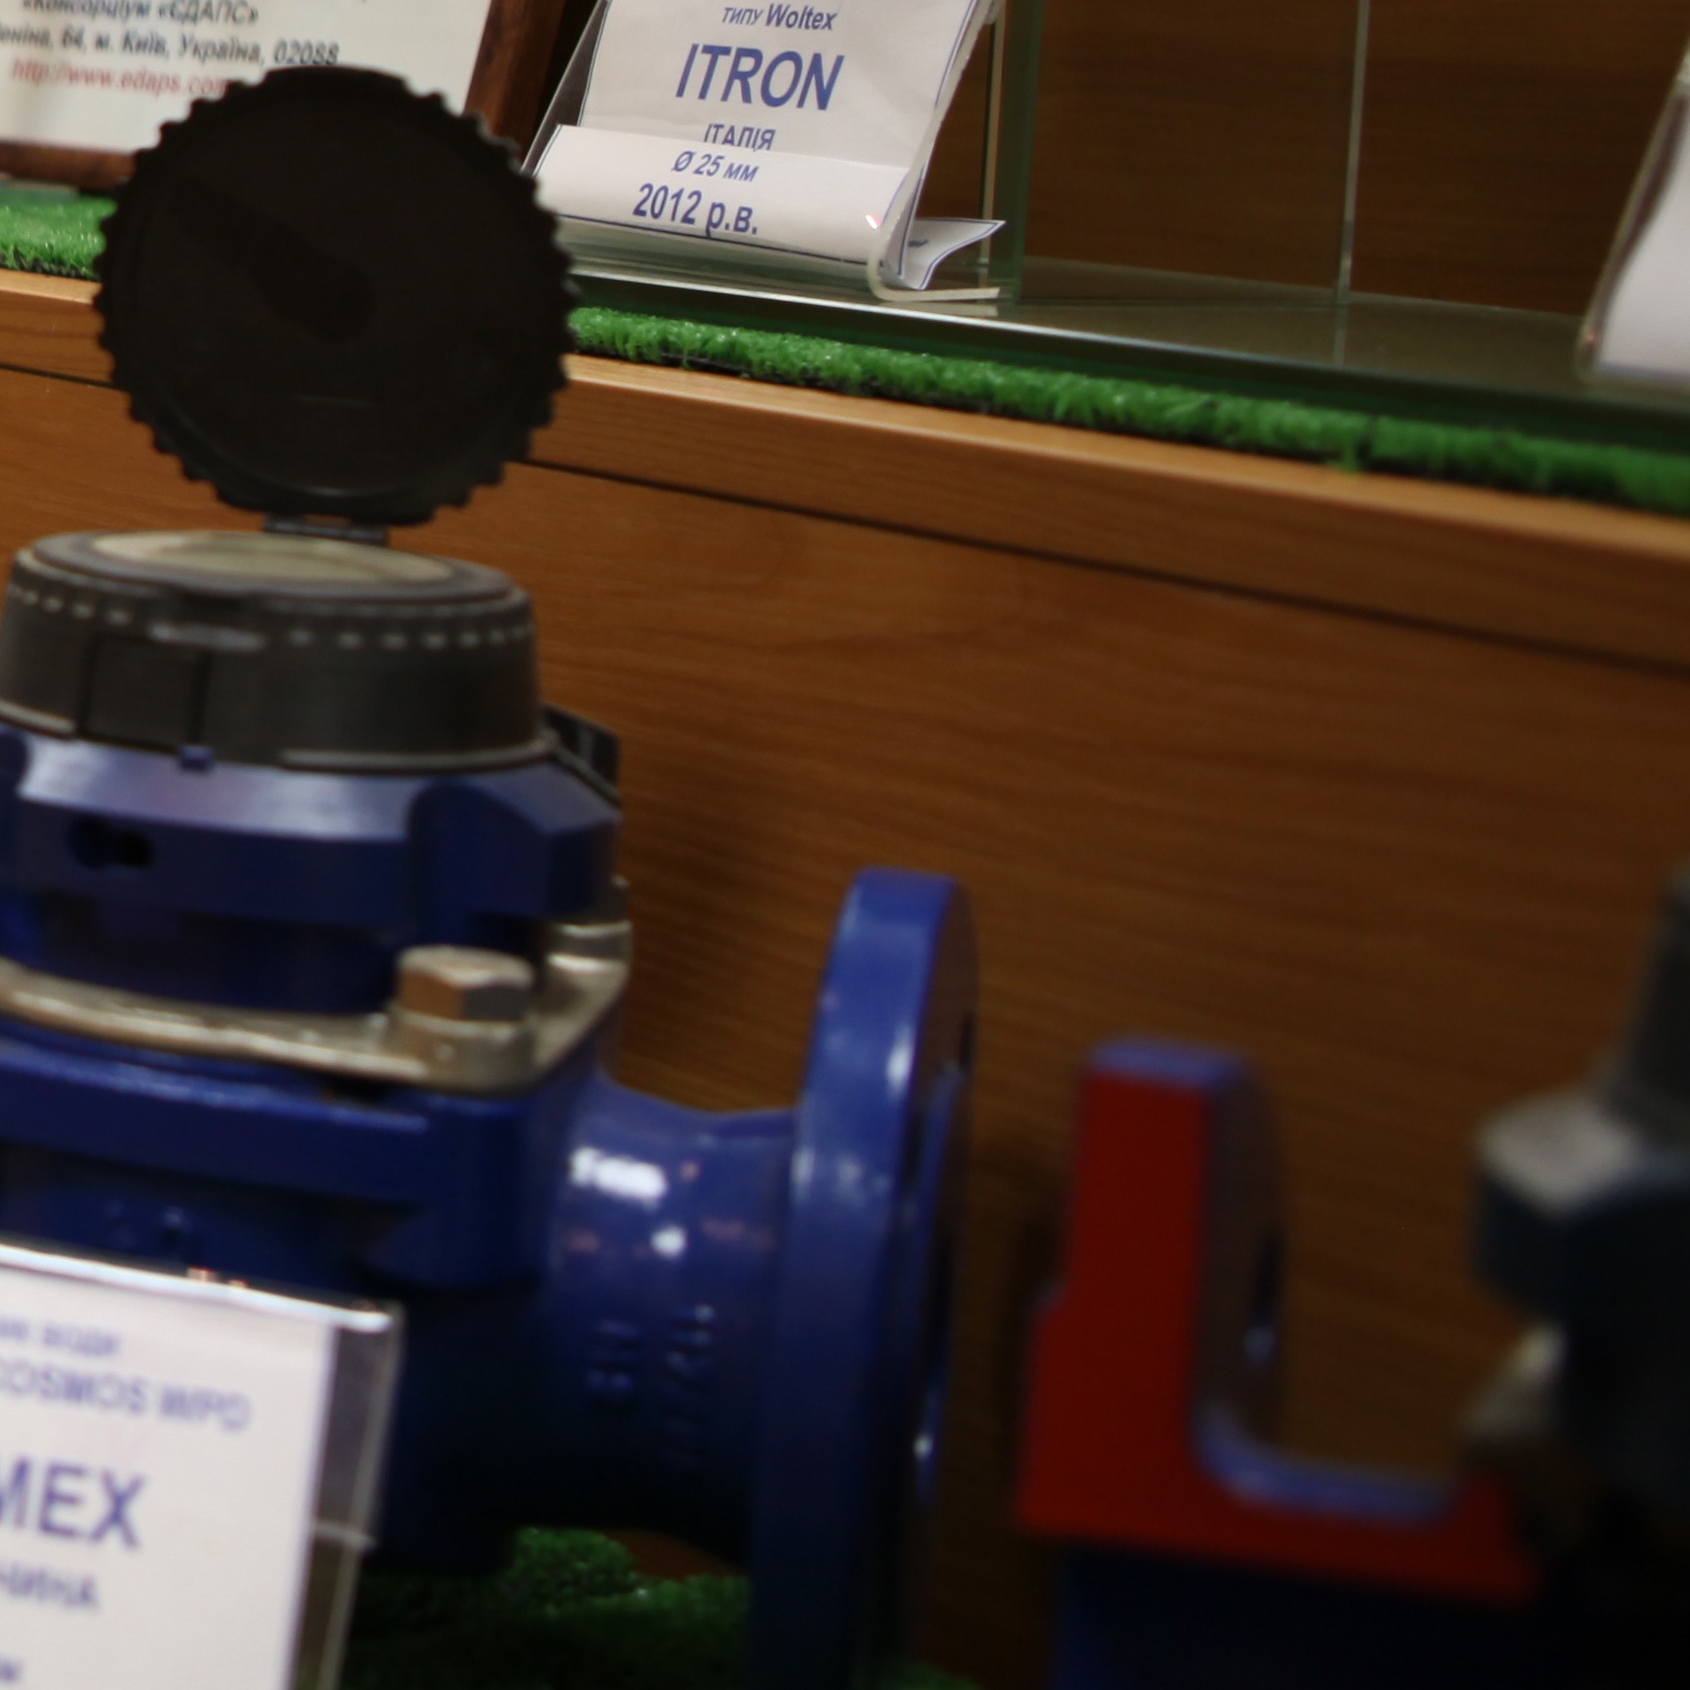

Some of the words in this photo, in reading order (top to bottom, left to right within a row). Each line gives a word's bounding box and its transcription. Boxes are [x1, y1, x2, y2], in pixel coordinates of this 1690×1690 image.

[721, 6, 763, 27] ТИПУ
[765, 3, 837, 32] Woltex
[675, 43, 845, 111] ITRON
[693, 154, 723, 178] 25
[633, 182, 704, 226] 2012
[705, 199, 758, 240] р.в.
